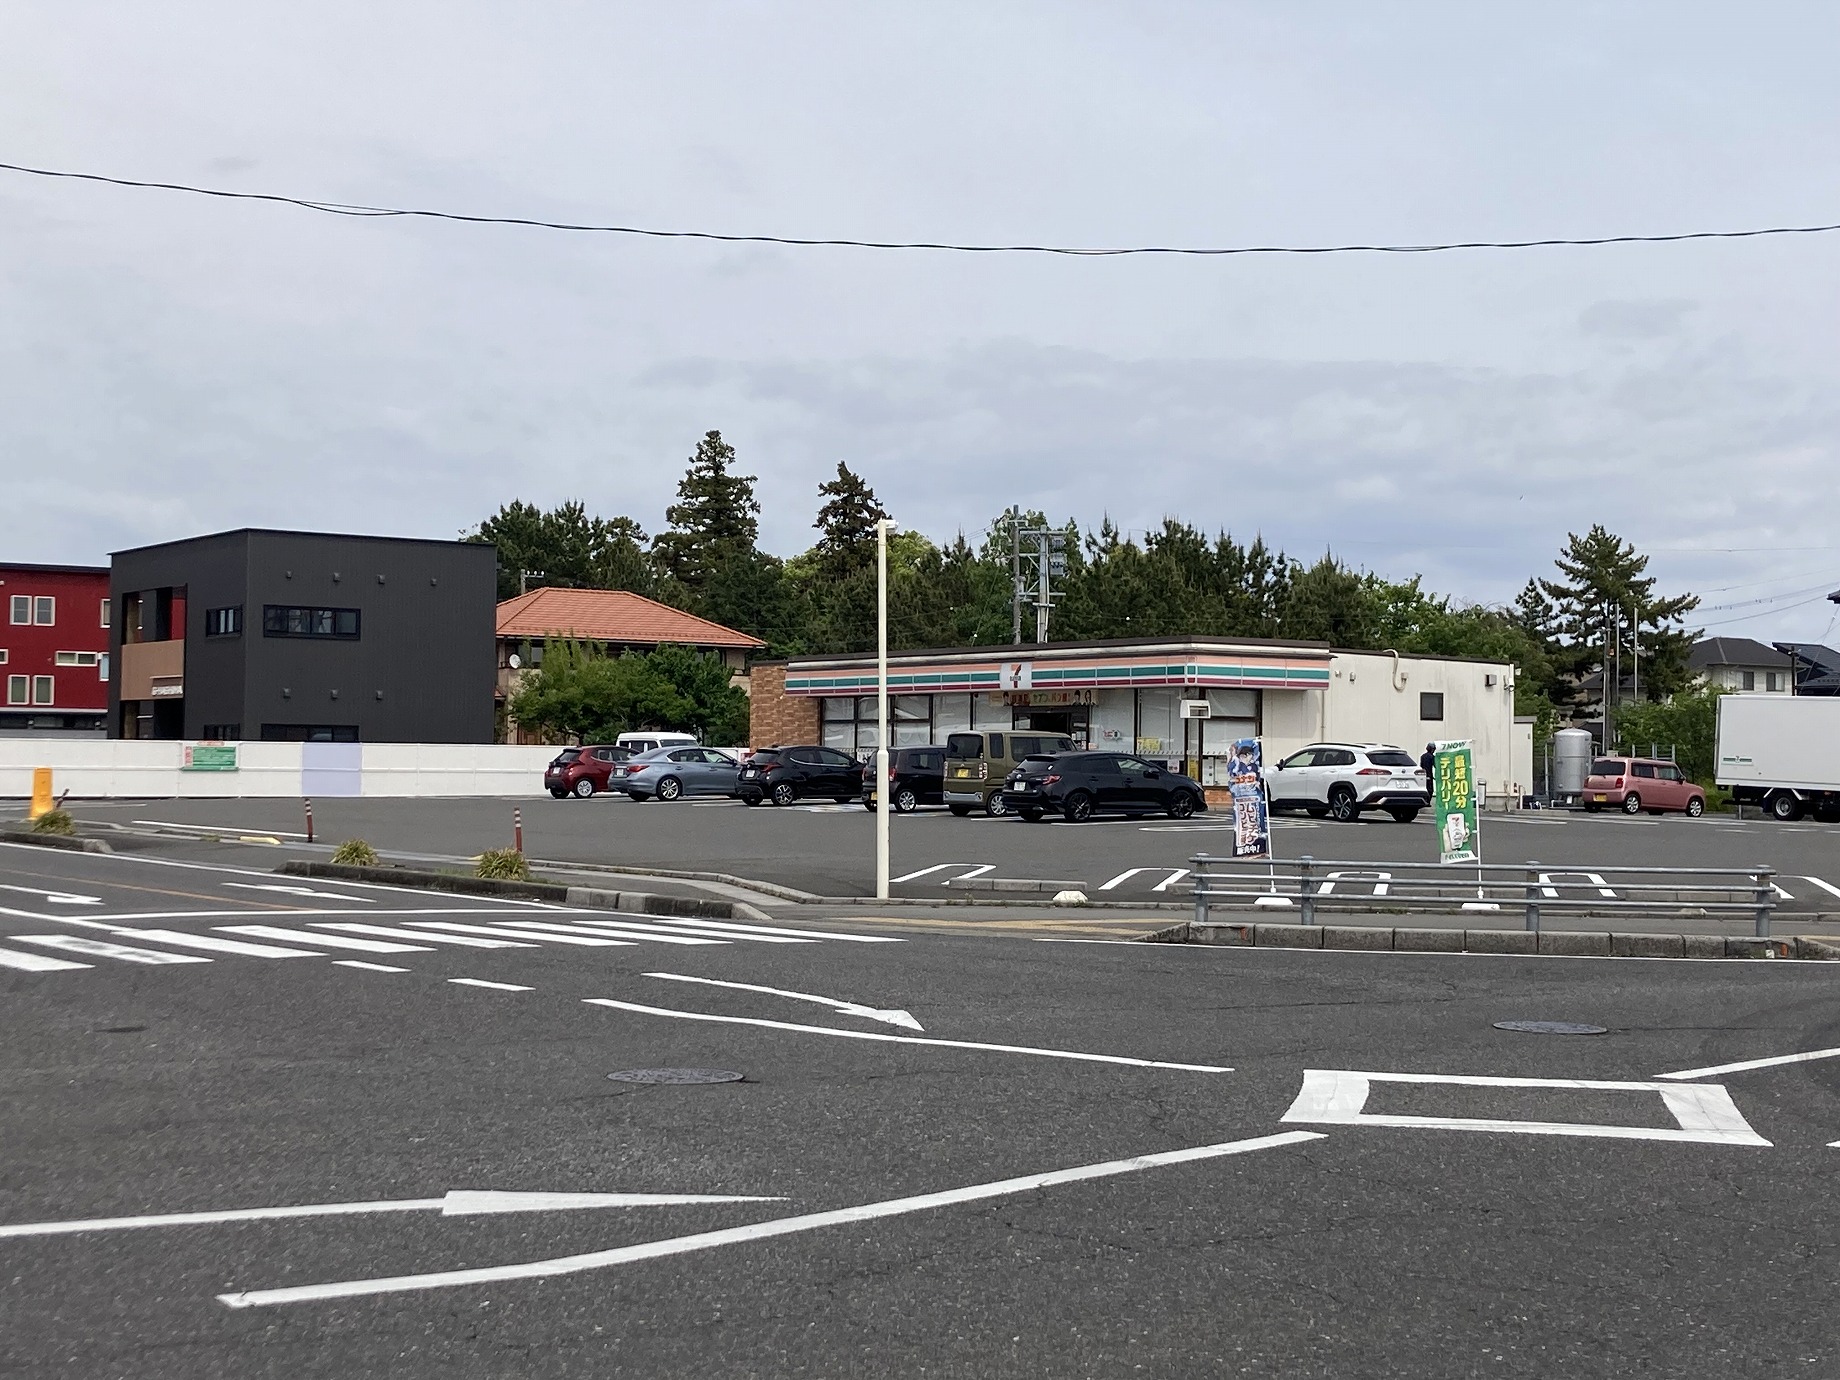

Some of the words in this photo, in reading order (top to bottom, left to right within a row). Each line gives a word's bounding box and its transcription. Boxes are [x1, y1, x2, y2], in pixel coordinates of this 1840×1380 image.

[1010, 664, 1022, 688] 7
[1440, 757, 1452, 811] デリバリー
[1453, 755, 1468, 809] 最短20分
